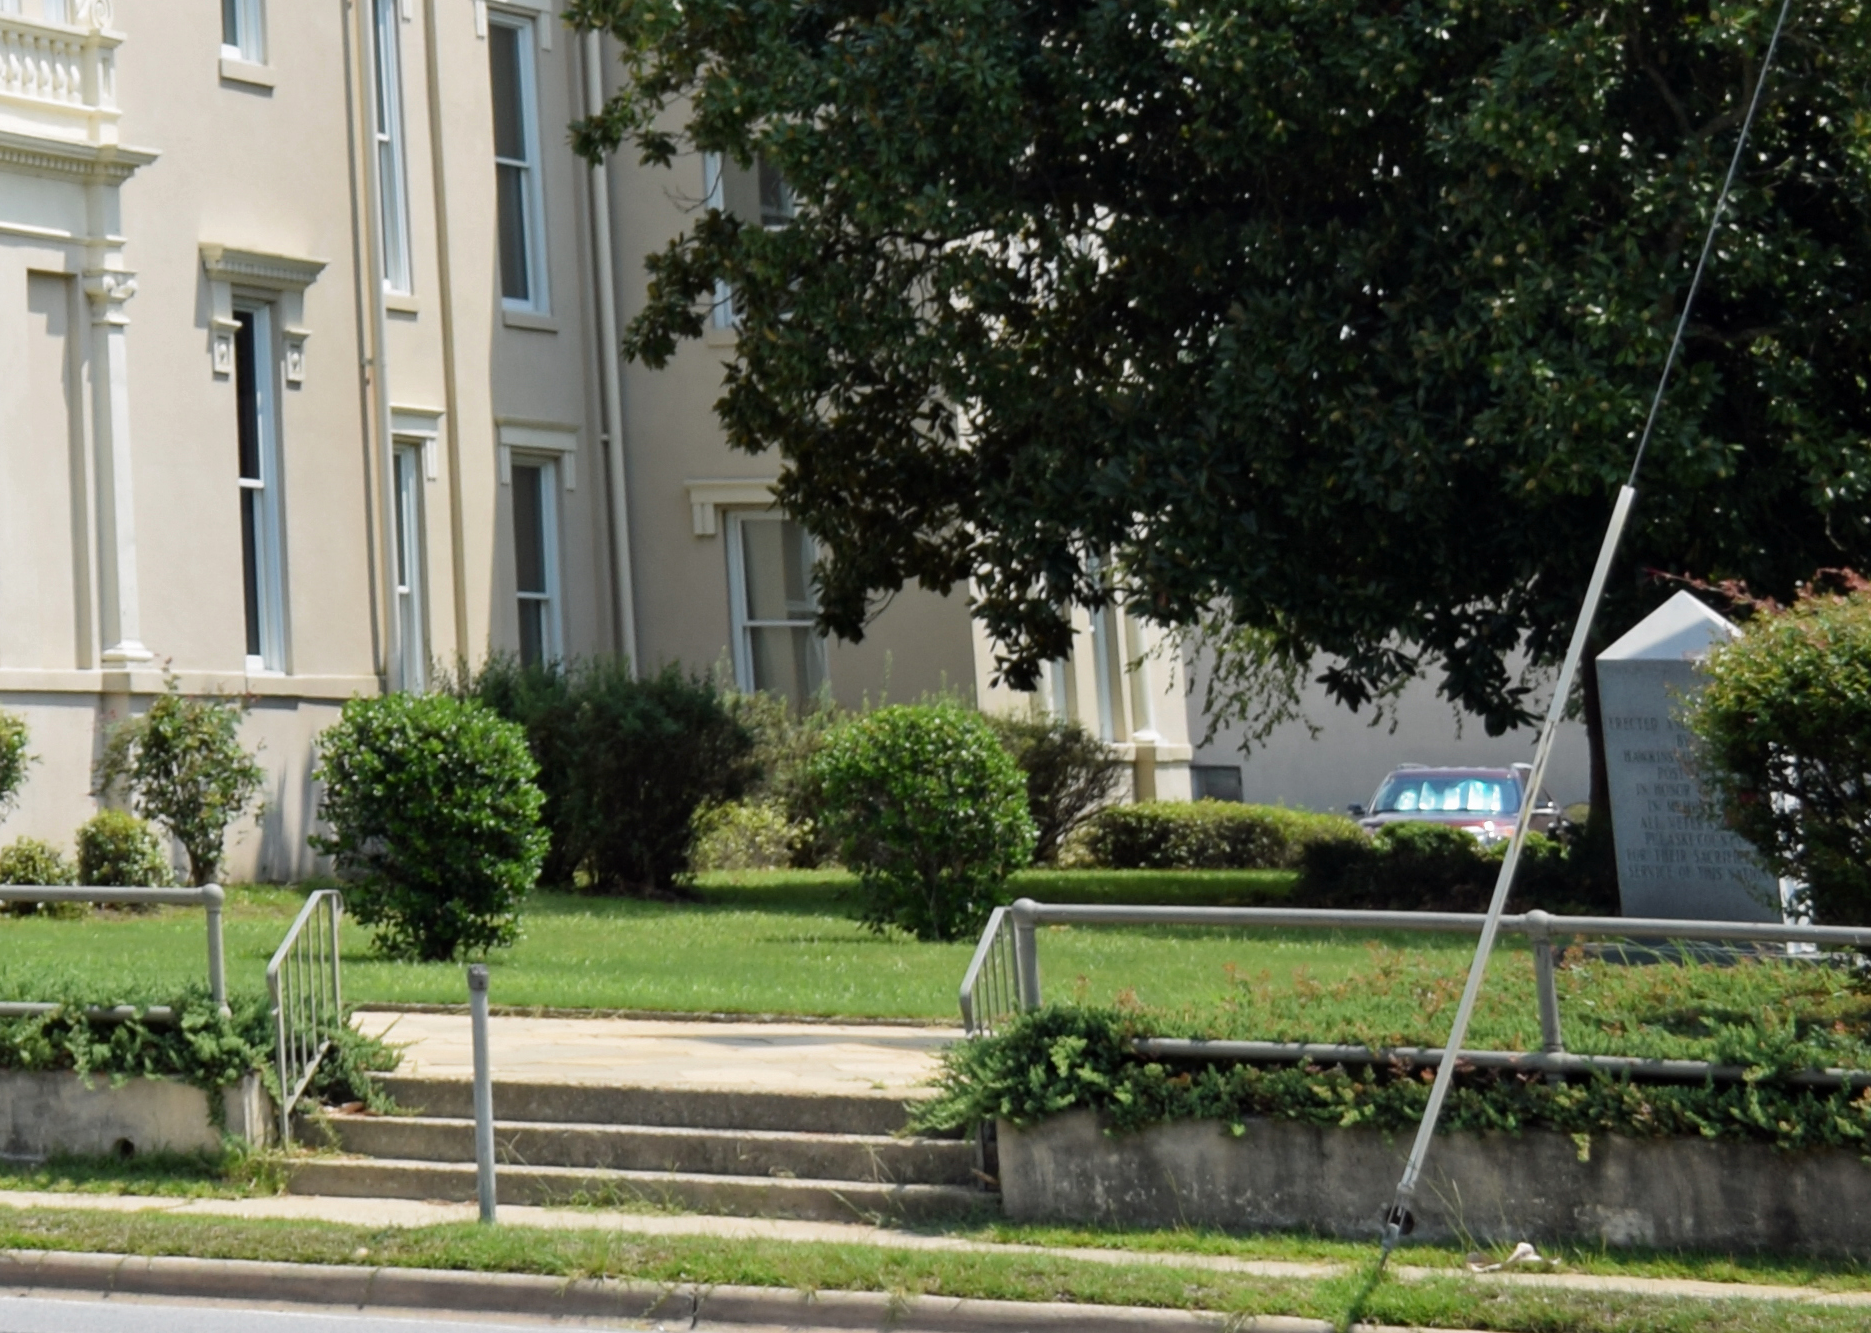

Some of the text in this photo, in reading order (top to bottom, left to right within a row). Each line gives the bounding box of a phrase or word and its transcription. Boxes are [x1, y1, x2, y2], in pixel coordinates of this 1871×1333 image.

[1609, 717, 1658, 731] ERECTED
[1654, 783, 1690, 797] HONOR
[1645, 832, 1692, 846] PULASKI
[1654, 848, 1687, 862] THEIR
[1628, 863, 1673, 879] SERVICE
